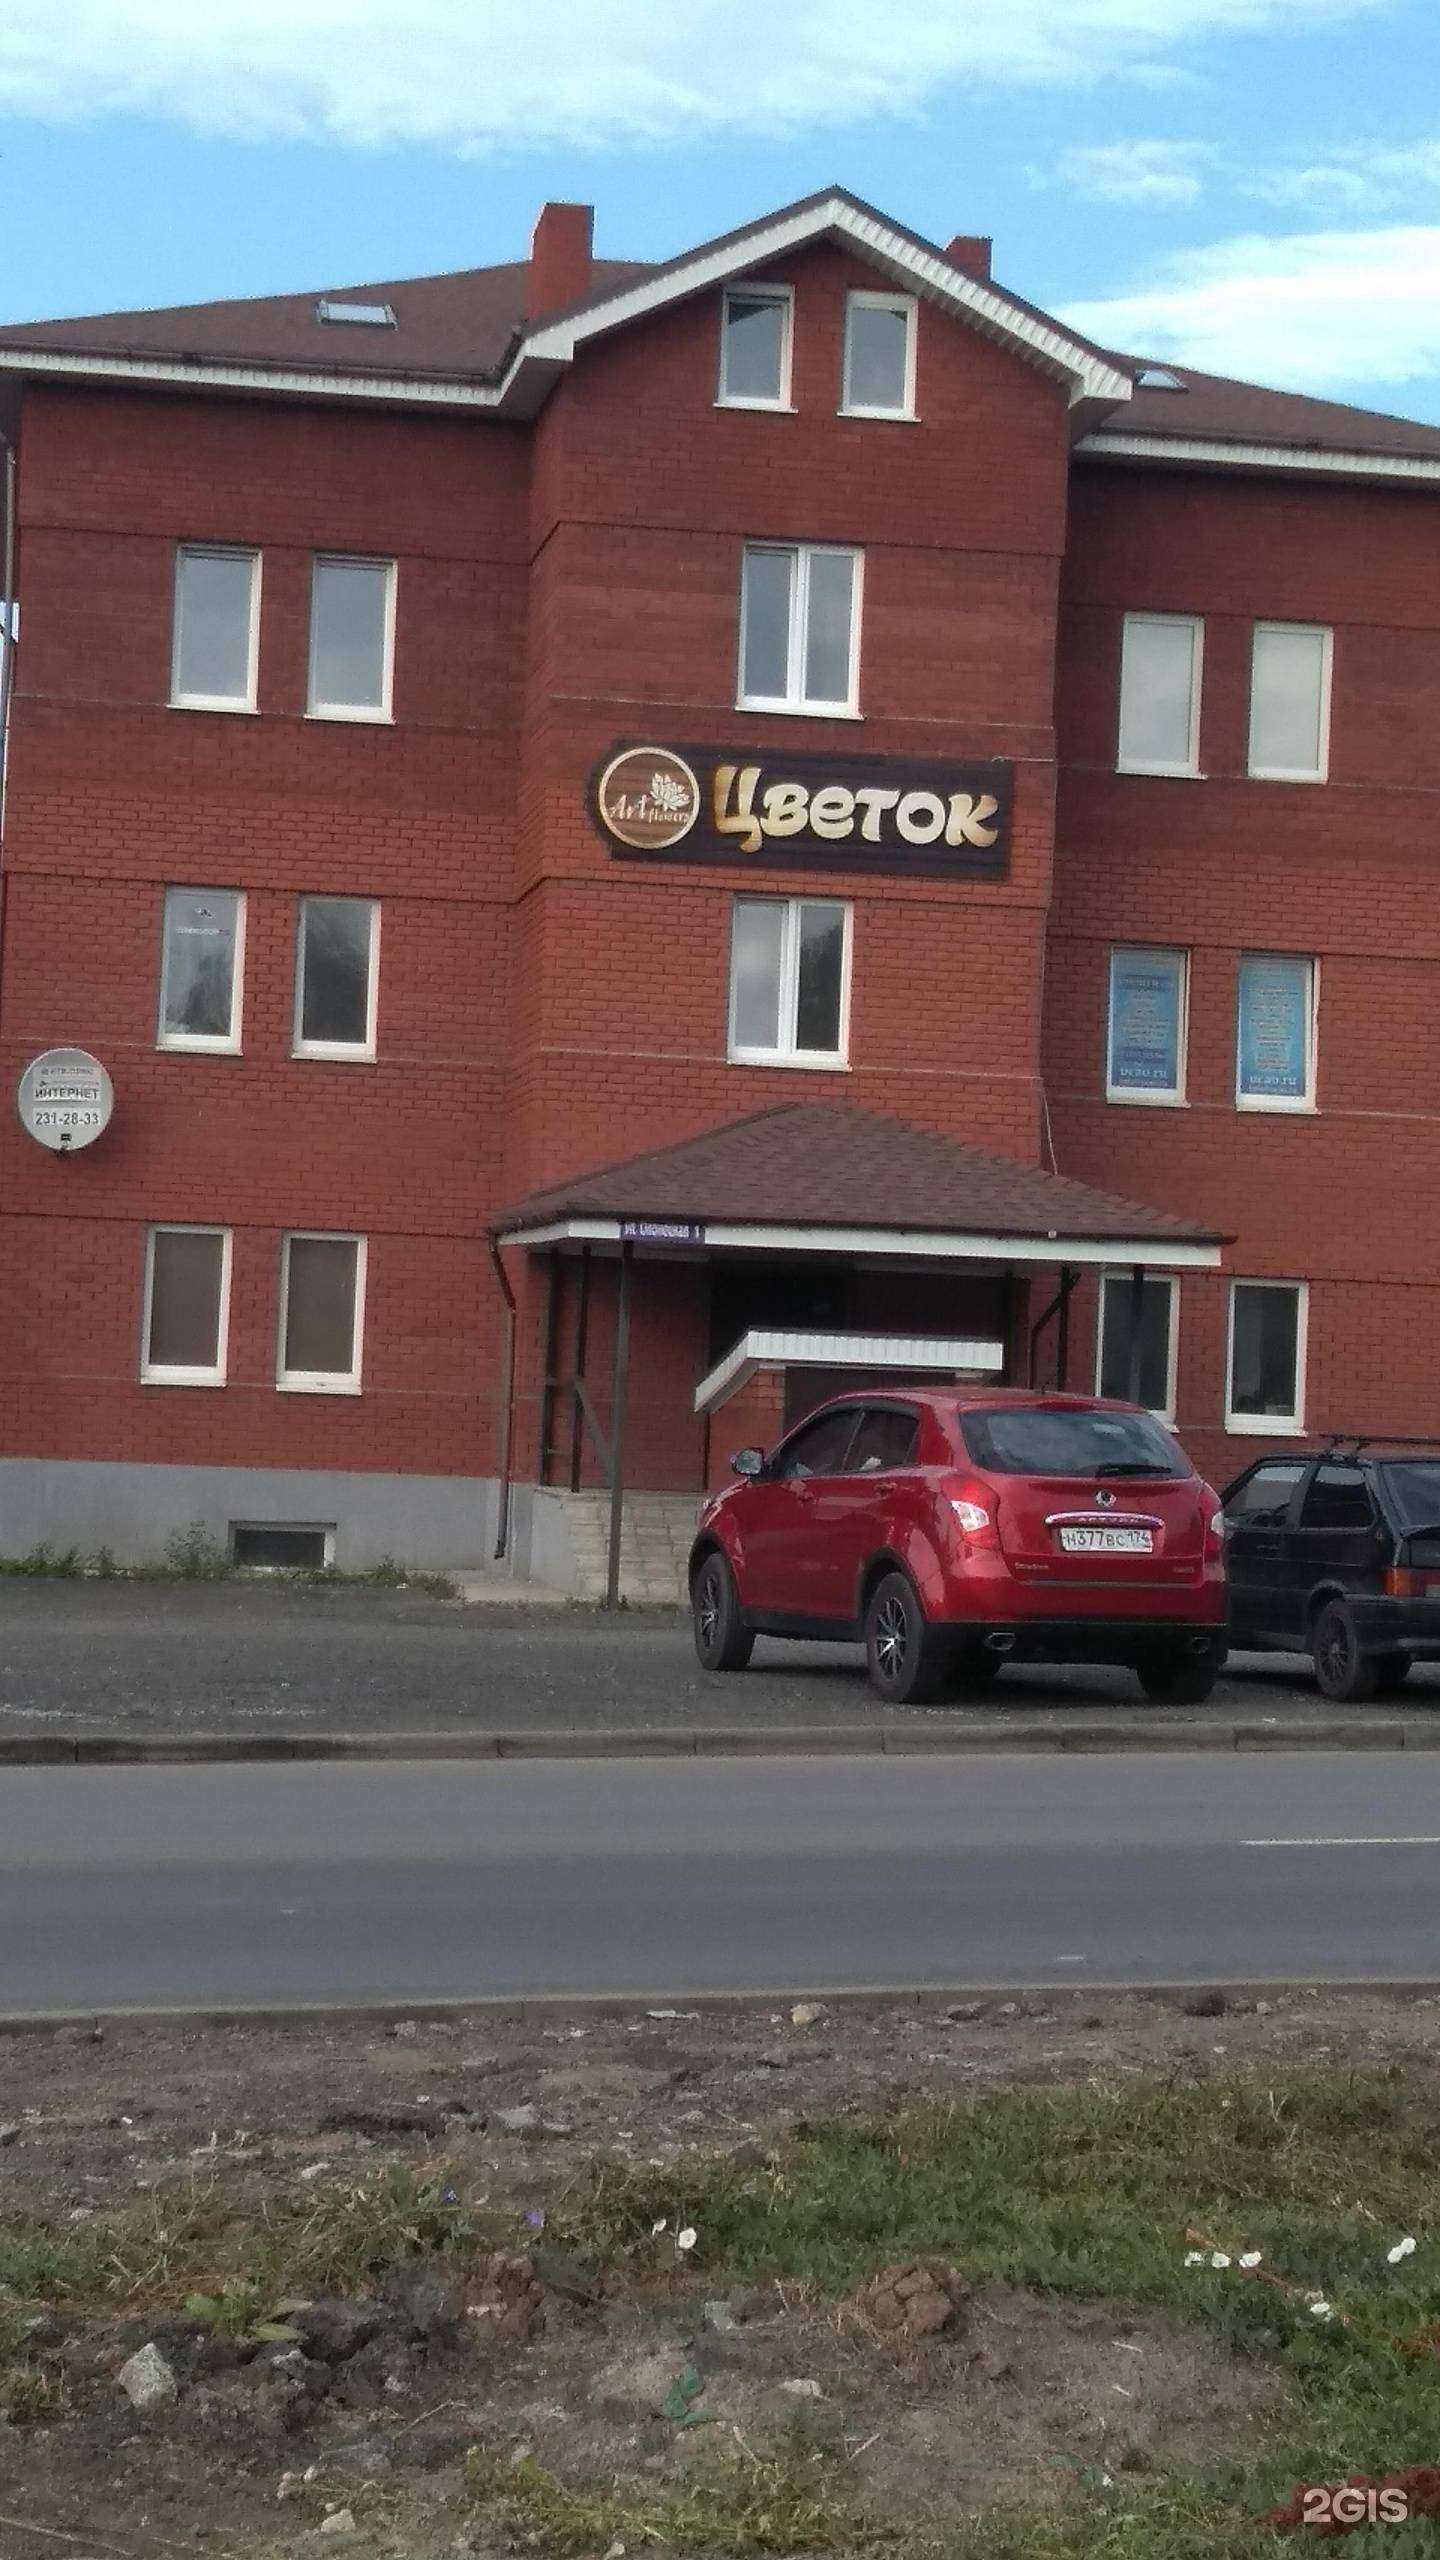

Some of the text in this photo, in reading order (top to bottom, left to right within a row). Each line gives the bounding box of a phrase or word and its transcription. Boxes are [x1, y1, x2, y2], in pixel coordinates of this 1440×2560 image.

[714, 766, 999, 853] Цветок
[35, 1087, 98, 1099] ИНТЕРНЕТ
[35, 1111, 99, 1125] 231-28-33
